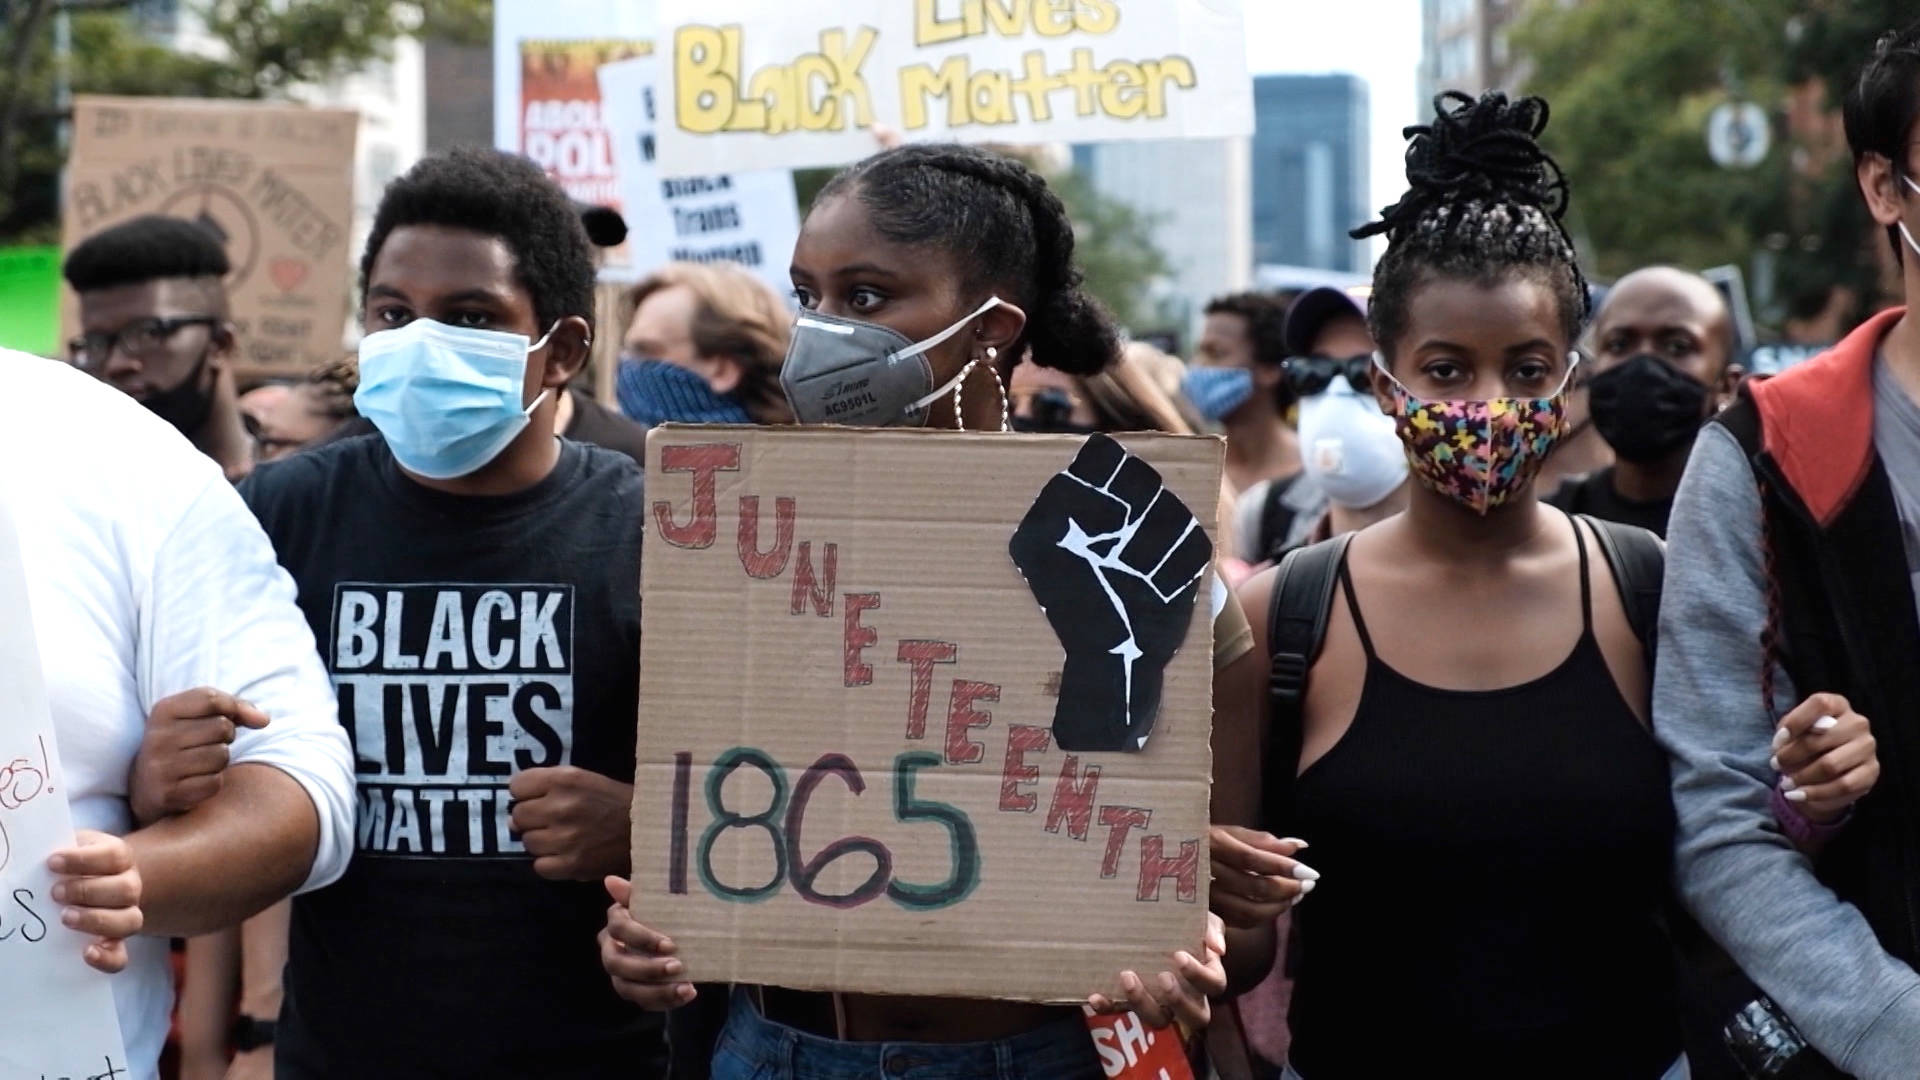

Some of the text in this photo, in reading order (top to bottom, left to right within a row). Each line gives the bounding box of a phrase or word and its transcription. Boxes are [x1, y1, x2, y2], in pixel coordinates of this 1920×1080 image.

[898, 47, 1197, 130] Matter
[74, 156, 170, 226] BLACK
[173, 146, 253, 184] LIVES
[673, 202, 740, 236] Trans
[824, 391, 878, 417] AC9501L
[336, 590, 566, 670] BLACK
[652, 442, 1200, 904] JUNETEENTH
[337, 681, 564, 776] LIVES
[667, 746, 982, 911] 1865
